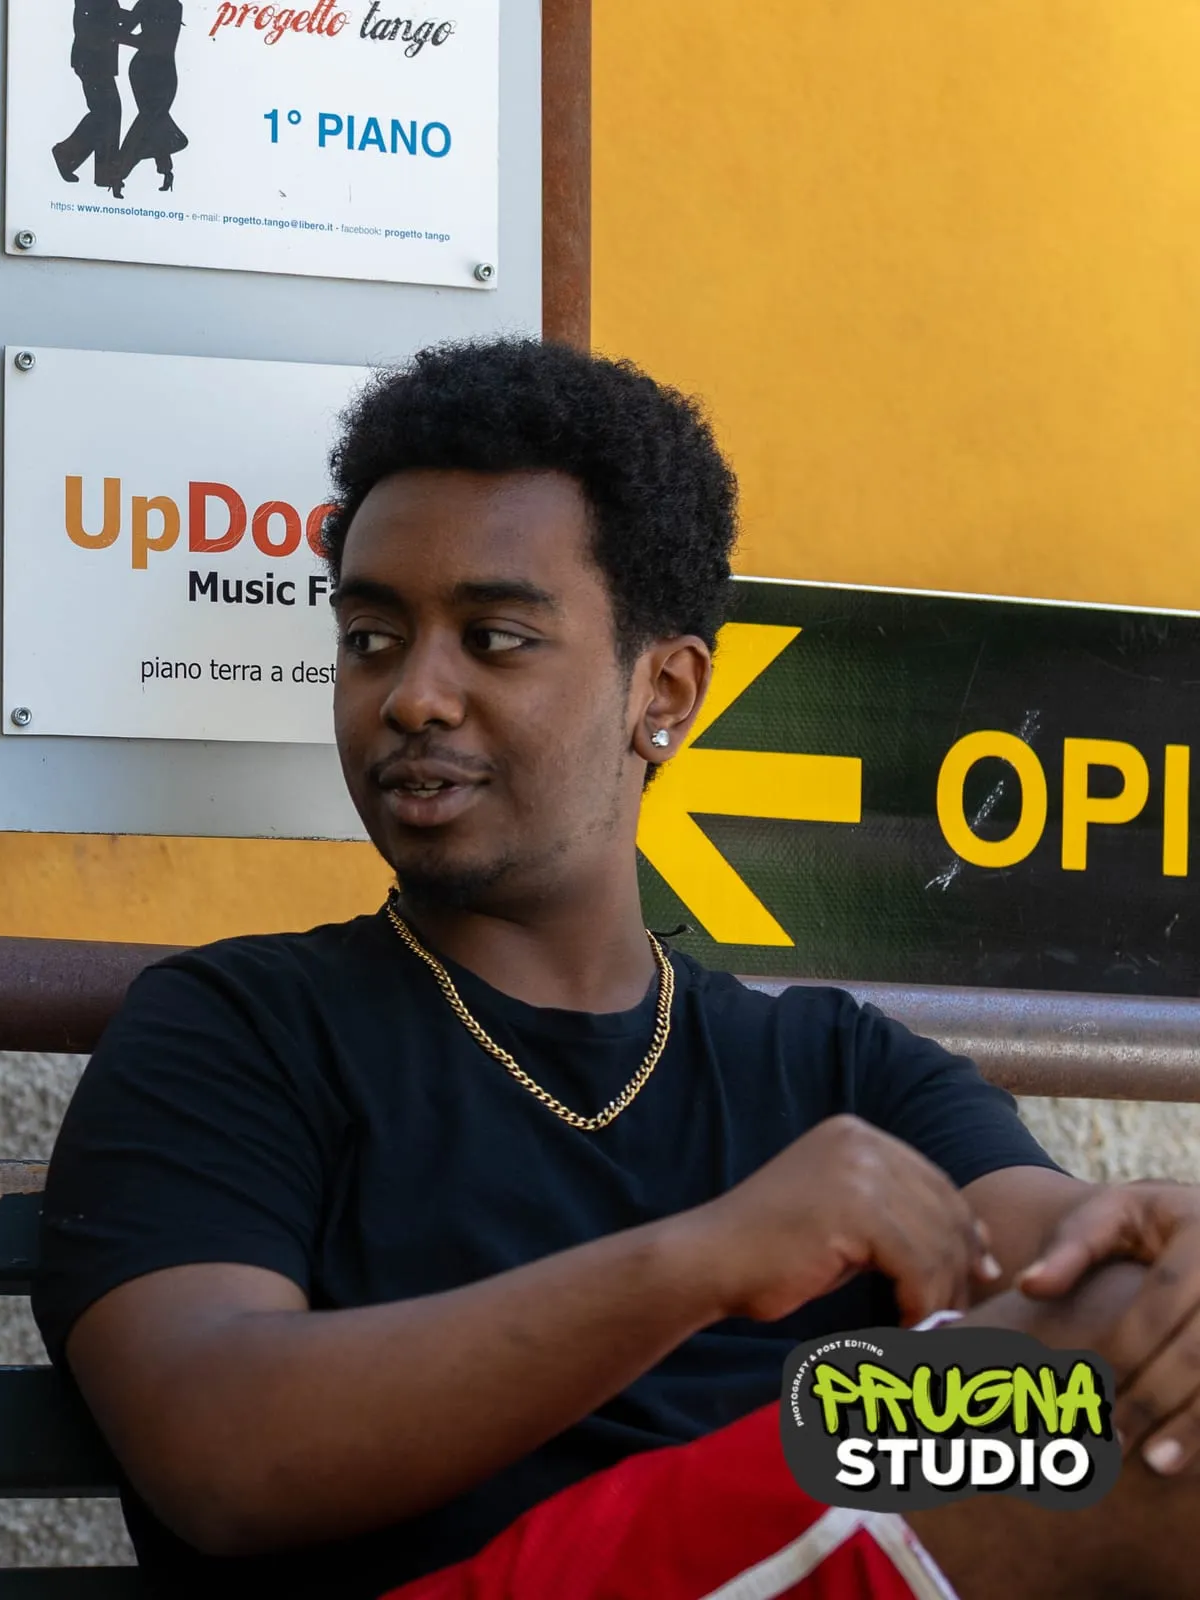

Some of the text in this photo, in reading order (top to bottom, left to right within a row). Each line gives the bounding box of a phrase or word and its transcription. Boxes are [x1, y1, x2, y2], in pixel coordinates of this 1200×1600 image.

[209, 0, 457, 58] progetto tango
[318, 112, 452, 158] PIANO
[50, 201, 75, 212] https:
[77, 203, 184, 221] www.nonsolotango.org
[192, 212, 221, 222] e-mail:
[222, 214, 333, 232] progetto.tango@libero.it
[341, 223, 382, 236] facebook:
[384, 228, 423, 240] progetto
[424, 232, 451, 242] tango
[188, 571, 296, 606] Music
[141, 657, 202, 683] piano
[210, 659, 262, 682] terra
[271, 665, 283, 683] a
[936, 730, 1190, 878] OPI
